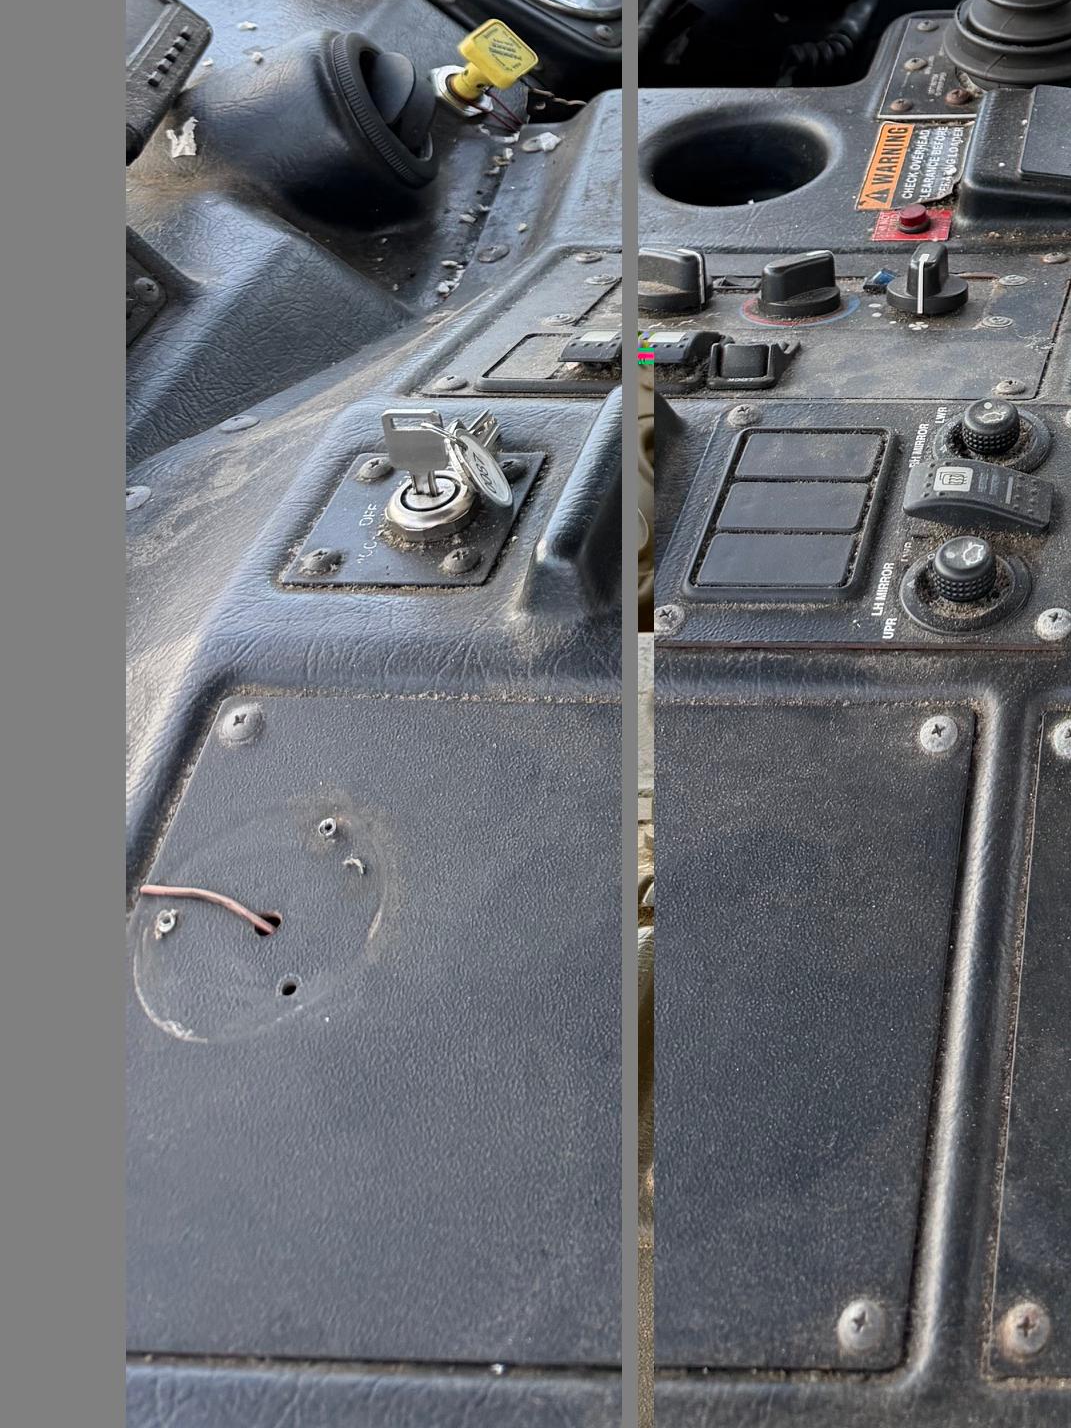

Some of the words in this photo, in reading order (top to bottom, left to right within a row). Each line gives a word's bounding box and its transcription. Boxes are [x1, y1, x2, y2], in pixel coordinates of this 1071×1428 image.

[871, 127, 909, 185] WARNING
[910, 129, 930, 171] OVERHEAD
[949, 127, 964, 158] LOADER
[919, 158, 939, 198] LEARANCE
[933, 126, 948, 156] BEFORE
[902, 172, 919, 199] CHECK
[935, 406, 948, 424] LWR
[913, 423, 929, 458] MIRROR
[359, 503, 378, 527] OFF
[875, 562, 895, 601] MIRROR
[871, 602, 885, 617] LH
[882, 617, 898, 640] UPR
